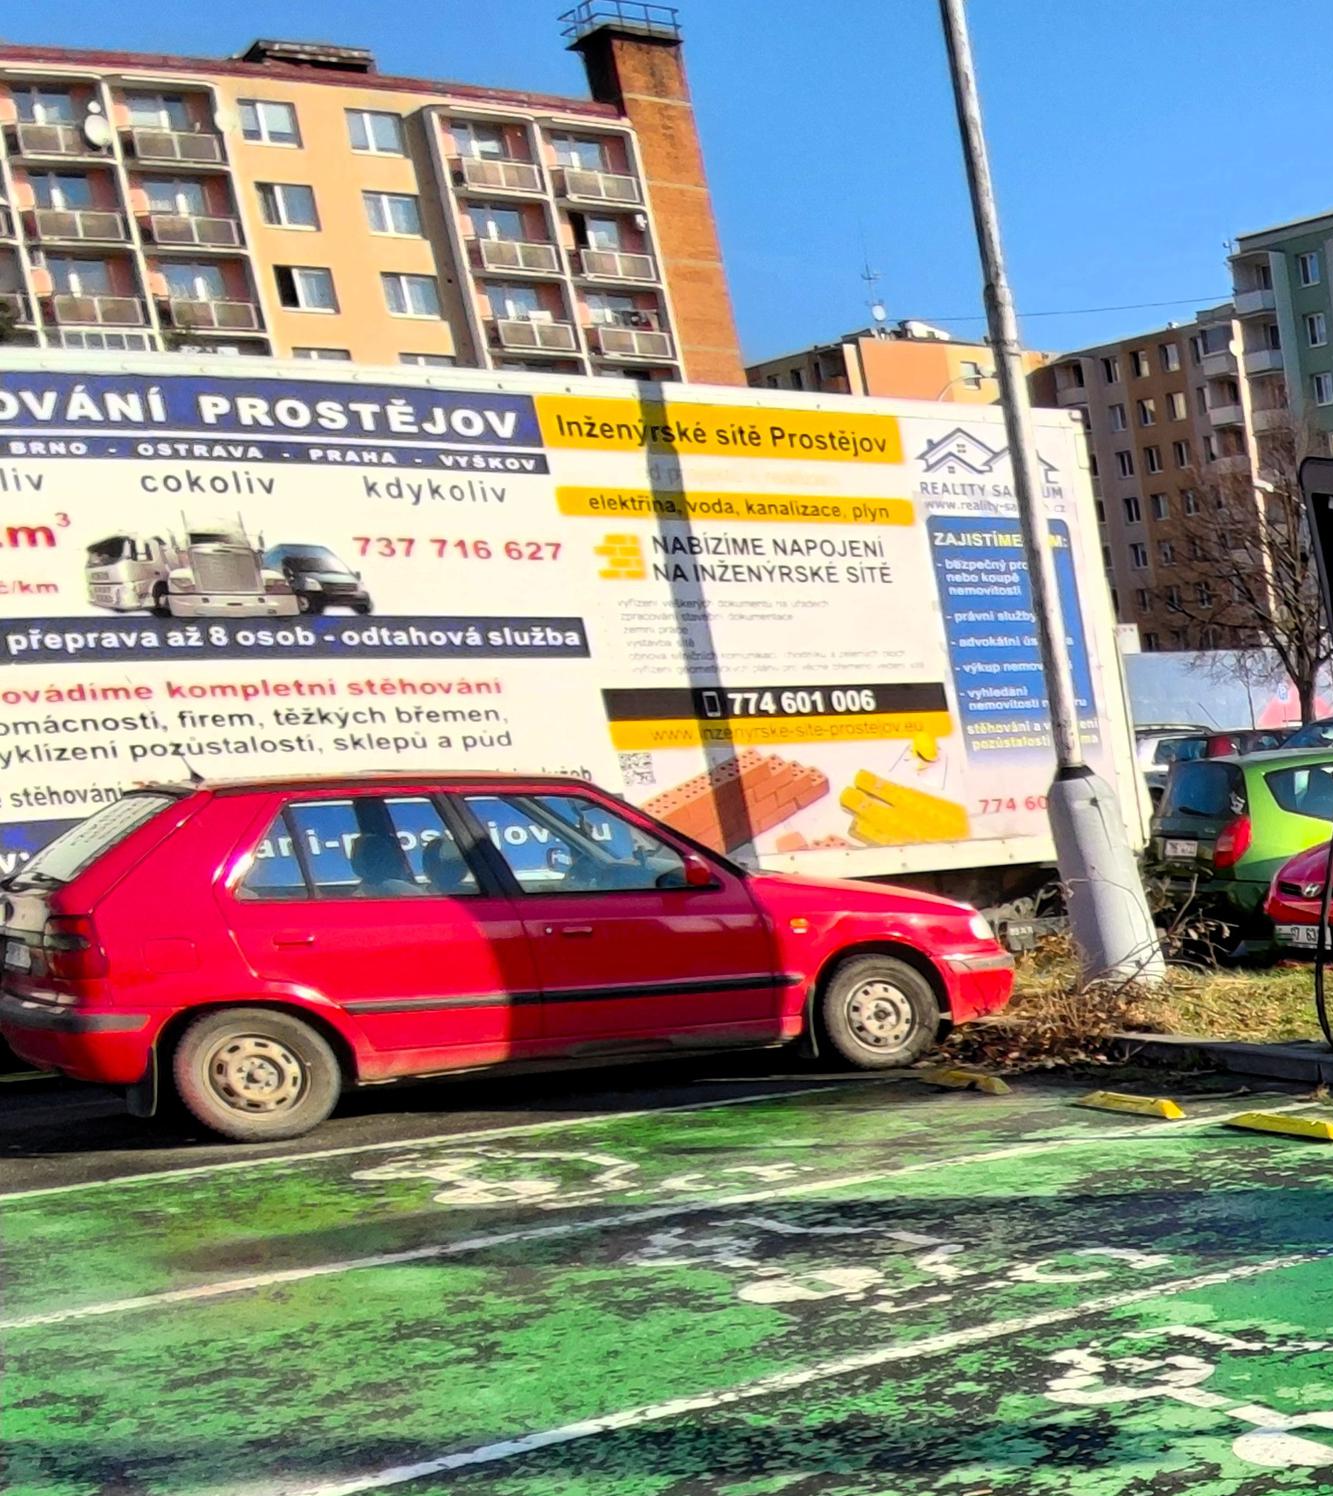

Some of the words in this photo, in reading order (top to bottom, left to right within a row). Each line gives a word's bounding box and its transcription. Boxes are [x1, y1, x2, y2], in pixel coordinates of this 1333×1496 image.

[198, 394, 516, 440] PROSTĚJOV
[556, 414, 707, 447] Inženýrské
[715, 423, 762, 447] sítě
[769, 426, 887, 457] Prostějov
[9, 441, 88, 455] BRNO
[137, 443, 264, 459] OSTRAVA
[308, 449, 397, 465] PRAHA
[438, 452, 536, 471] VYŠKOV
[140, 470, 275, 495] cokoliv
[363, 476, 506, 506] kdykoliv
[920, 481, 986, 497] REALITY
[589, 495, 682, 515] elektřina,
[688, 498, 740, 516] voda,
[746, 499, 847, 518] kanalizace,
[852, 503, 890, 521] plyn
[352, 536, 416, 558] 737
[430, 538, 492, 560] 716
[504, 541, 562, 561] 627
[651, 532, 767, 556] NABÍZÍME
[771, 535, 885, 558] NAPOJENÍ
[934, 530, 1024, 547] ZAJISTÍME
[652, 562, 690, 582] NA
[693, 559, 840, 583] INŽENÝRSKÉ
[846, 561, 893, 584] SÍTĚ
[945, 558, 1007, 572] bezpečný
[945, 572, 979, 582] nebo
[981, 572, 1020, 584] koupě
[954, 610, 995, 624] právní
[7, 628, 160, 655] přeprava
[167, 626, 204, 647] až
[208, 626, 229, 646] 8
[236, 627, 316, 647] osob
[341, 625, 483, 646] odtahová
[487, 626, 581, 647] služba
[963, 661, 1000, 674] výkup
[166, 678, 336, 701] kompletní
[346, 677, 503, 696] stěhování
[727, 692, 777, 715] 774
[781, 691, 826, 714] 601
[832, 689, 877, 712] 006
[177, 710, 265, 729] firem,
[273, 707, 386, 729] těžkých
[395, 705, 508, 724] břemen,
[129, 733, 324, 762] pozůstalostí,
[333, 731, 428, 754] sklepů
[437, 735, 452, 748] a
[461, 729, 513, 752] půd
[979, 799, 1016, 814] 774
